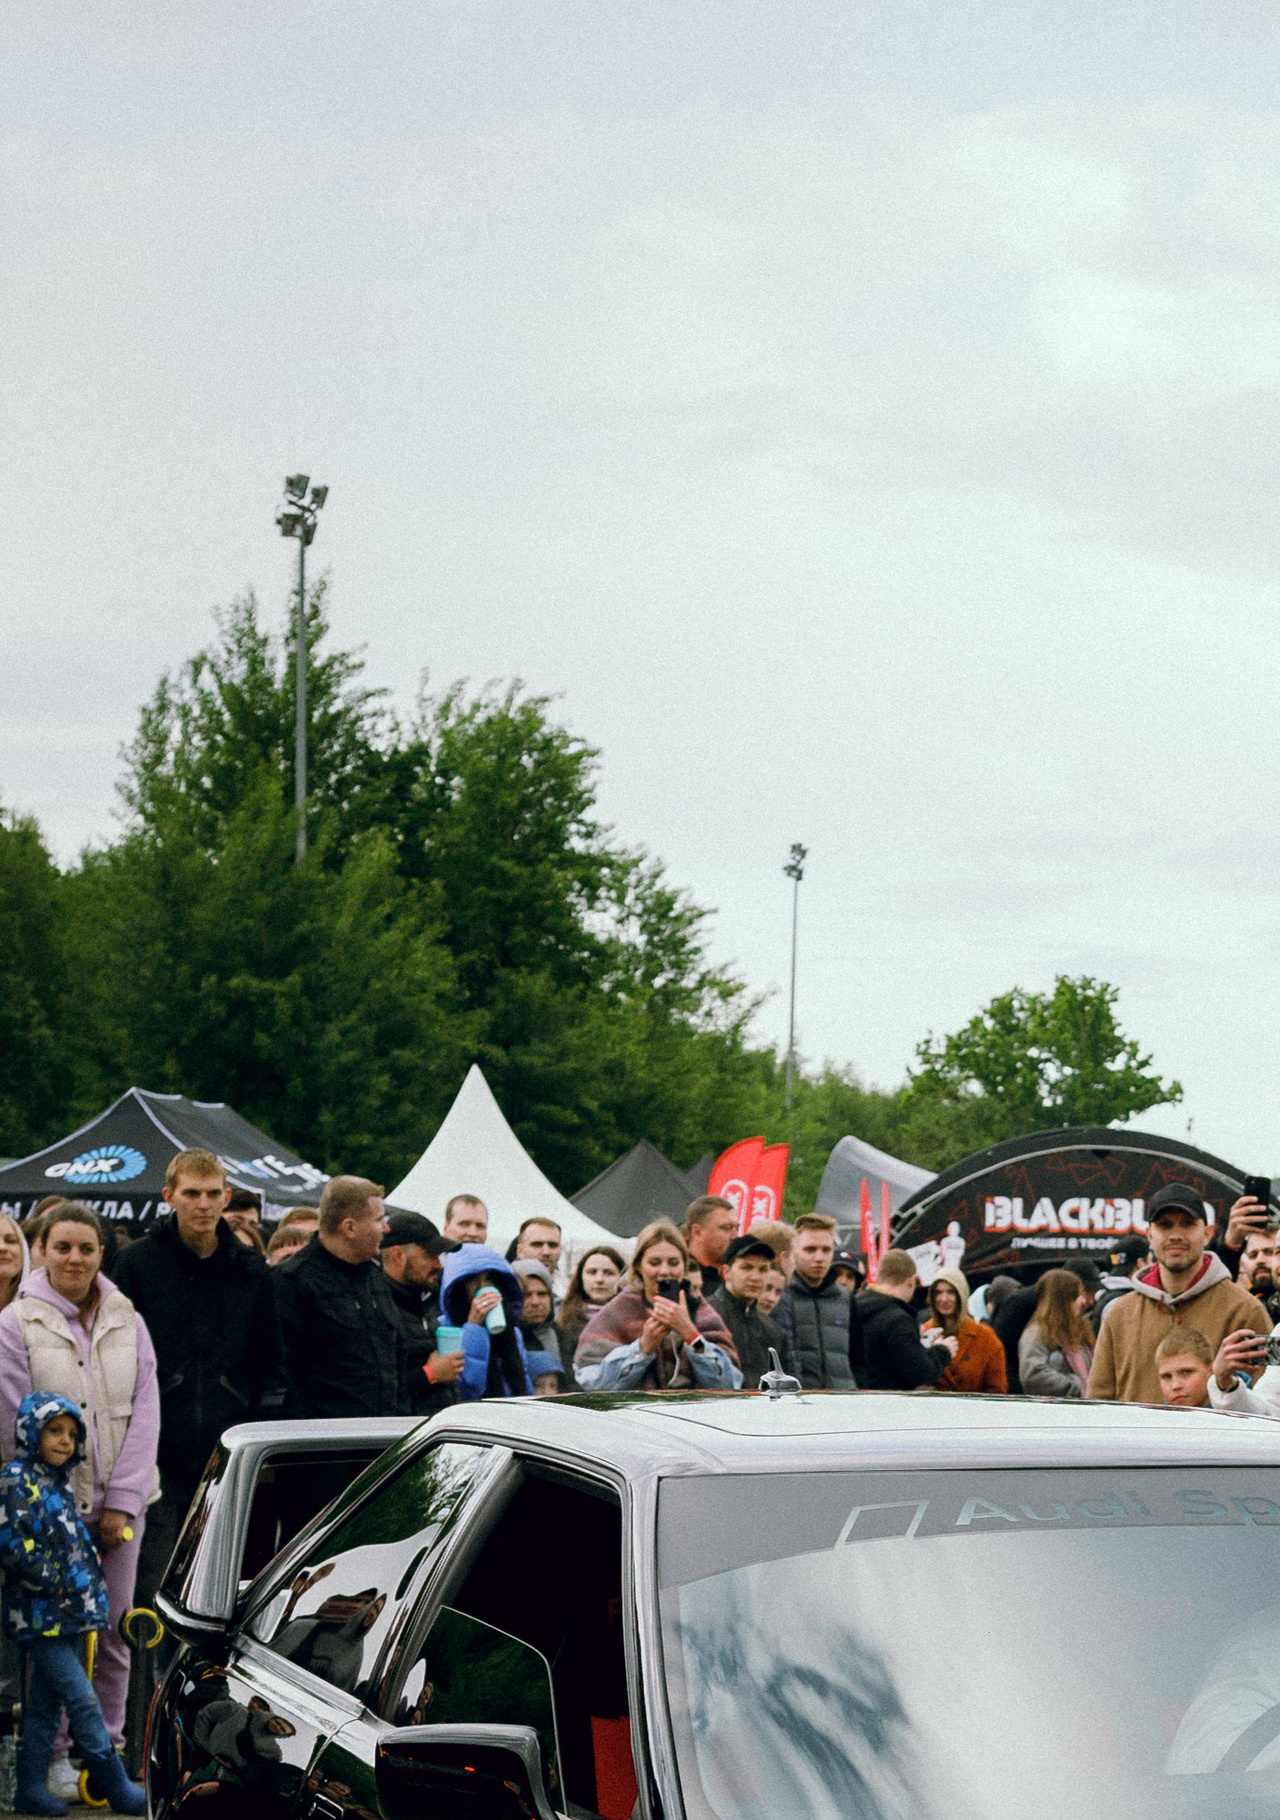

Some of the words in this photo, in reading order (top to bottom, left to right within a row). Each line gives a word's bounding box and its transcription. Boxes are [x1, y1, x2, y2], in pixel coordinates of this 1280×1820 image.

[44, 1158, 120, 1178] GNX
[984, 1195, 1215, 1234] BLACKBL
[955, 1489, 1148, 1526] Audi
